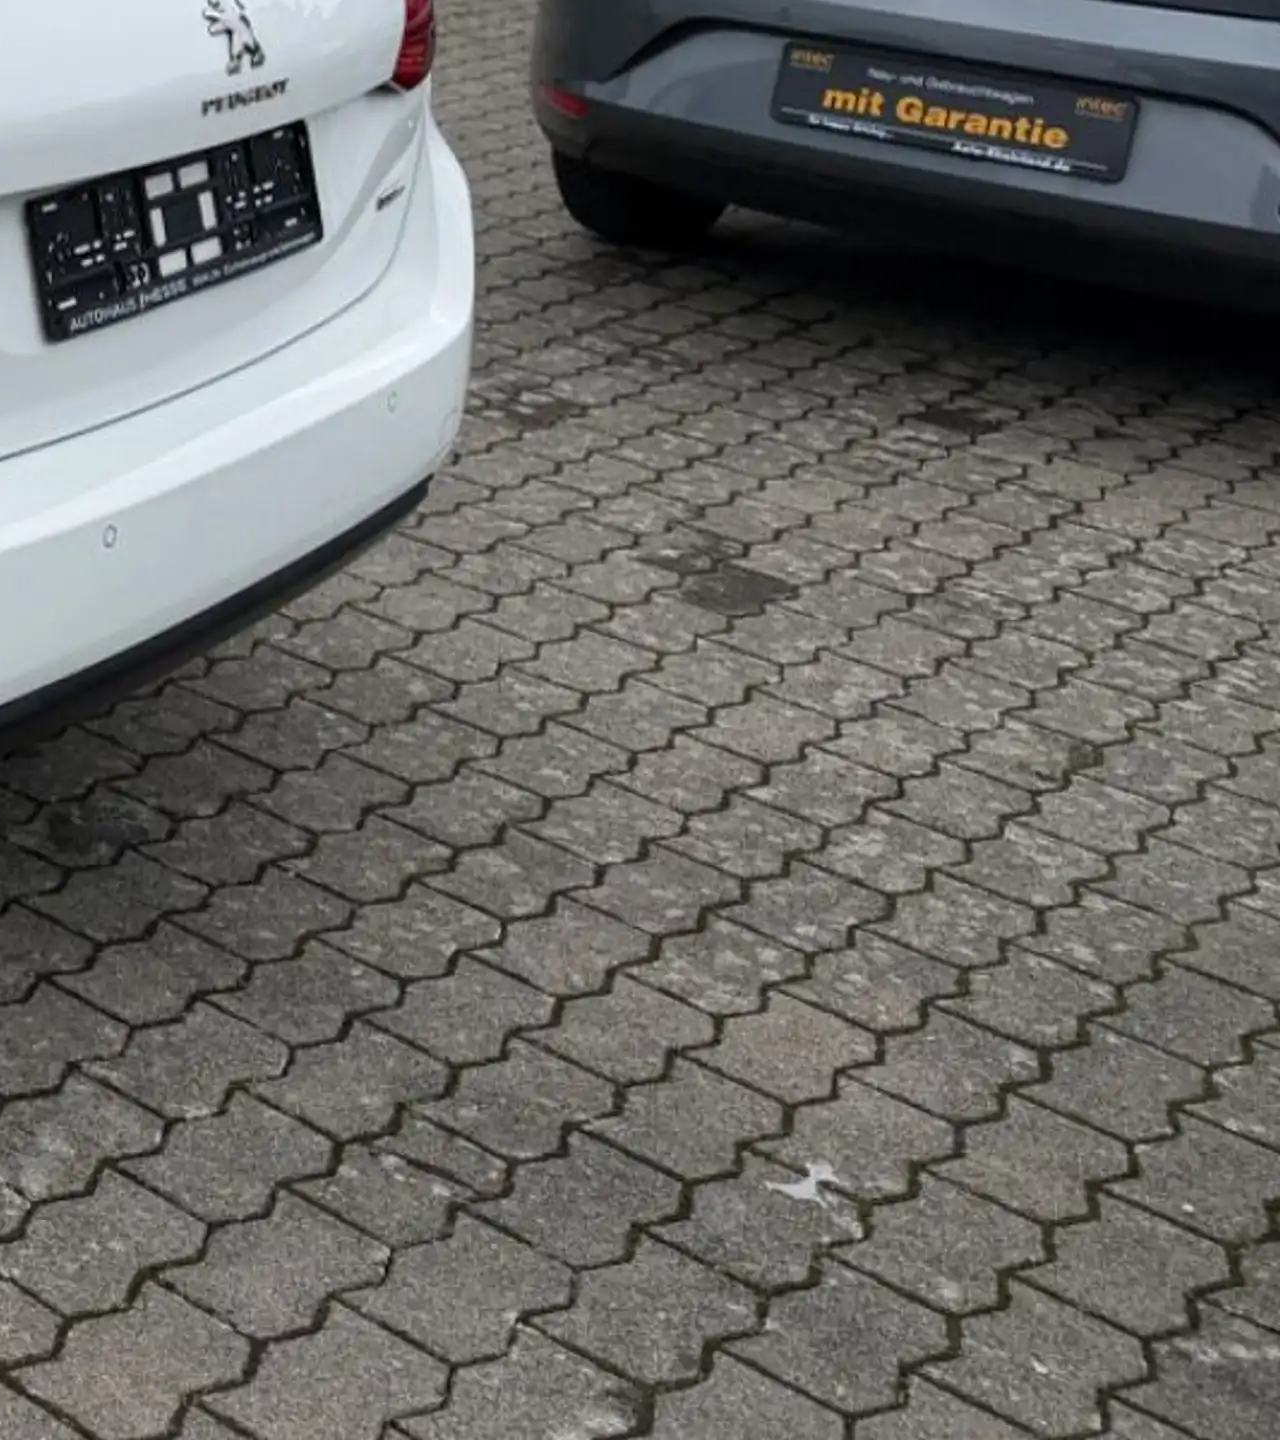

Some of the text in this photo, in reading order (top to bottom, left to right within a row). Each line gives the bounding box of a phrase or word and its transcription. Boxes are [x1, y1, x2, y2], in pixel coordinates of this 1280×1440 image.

[201, 76, 290, 117] PEUGEOT
[821, 86, 885, 117] mit
[896, 95, 1071, 149] Garantie
